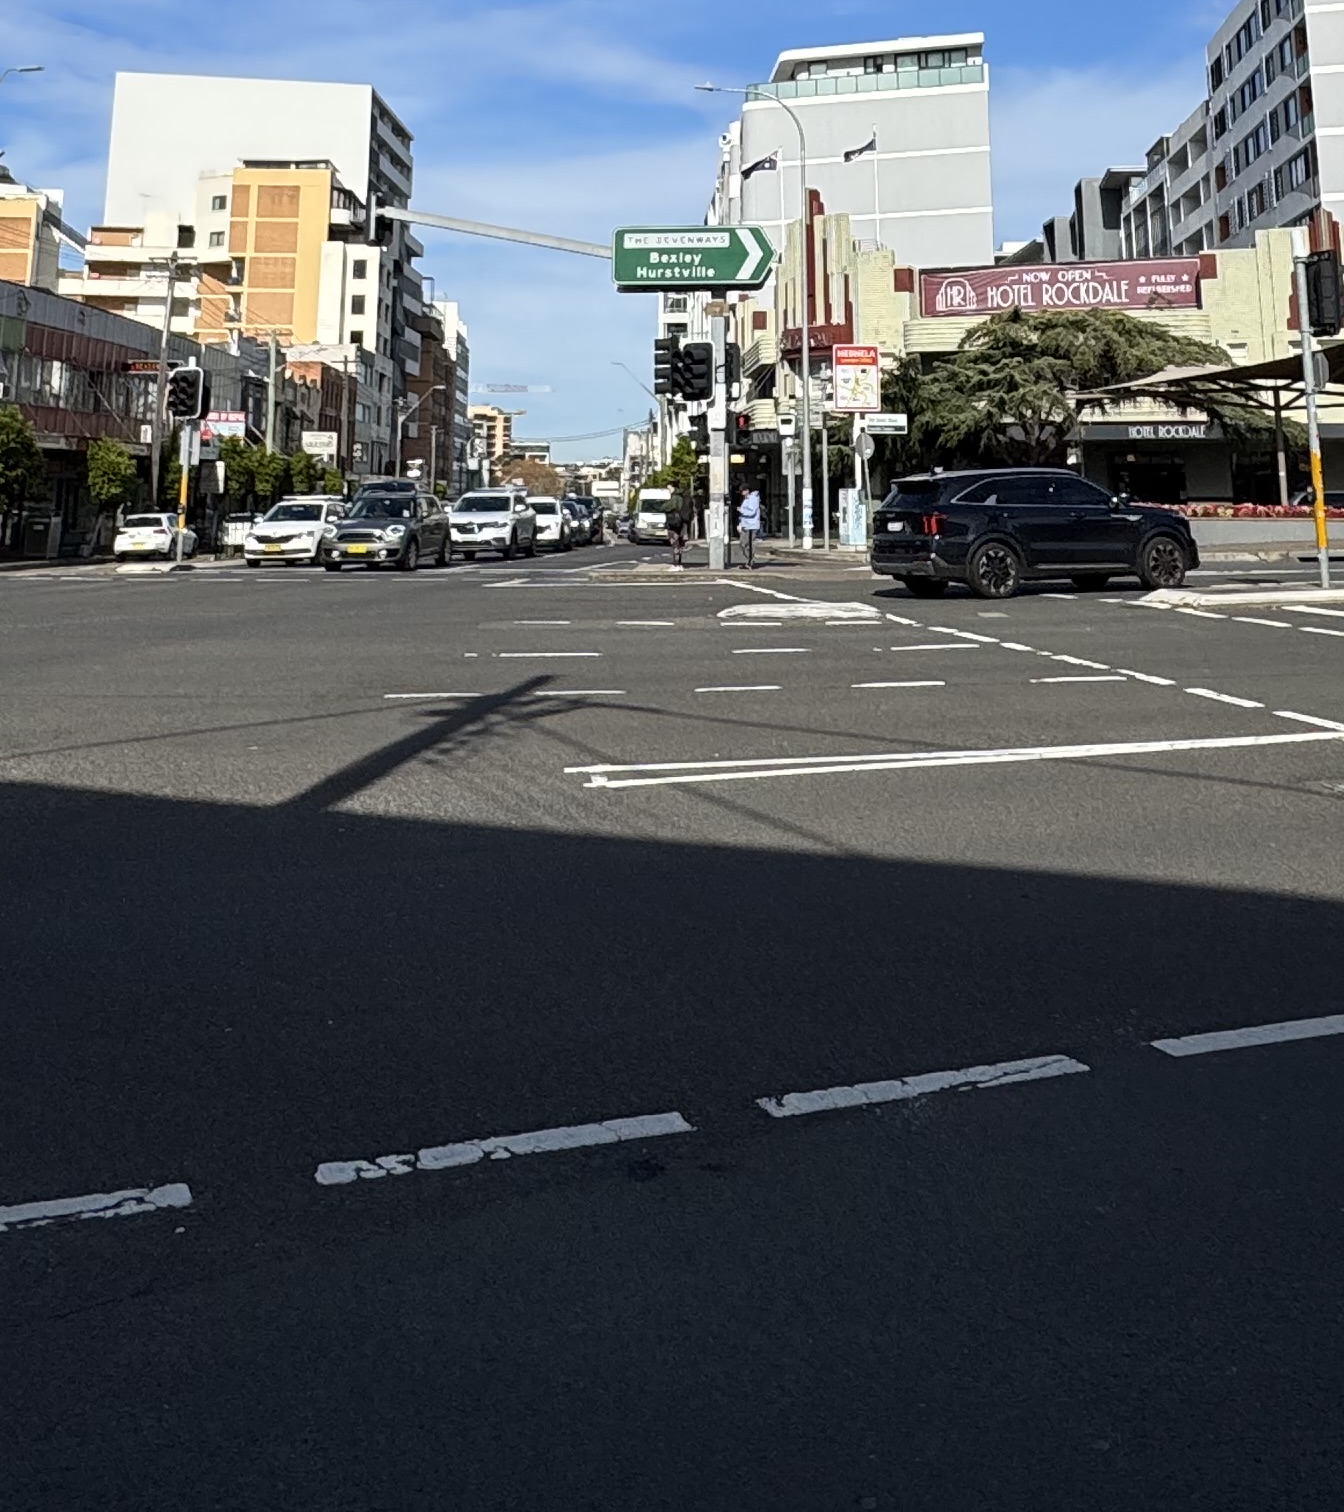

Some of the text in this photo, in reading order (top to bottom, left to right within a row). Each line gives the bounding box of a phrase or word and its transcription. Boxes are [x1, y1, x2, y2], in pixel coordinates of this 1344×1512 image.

[649, 251, 702, 265] Bexley
[636, 266, 716, 278] Hurstville
[1022, 270, 1092, 283] NOW OPEN
[1151, 274, 1176, 284] FULLY
[947, 285, 965, 306] HR
[987, 280, 1130, 308] HOTEL ROCKDALE
[1128, 424, 1207, 438] HOTEL ROCKDALE
